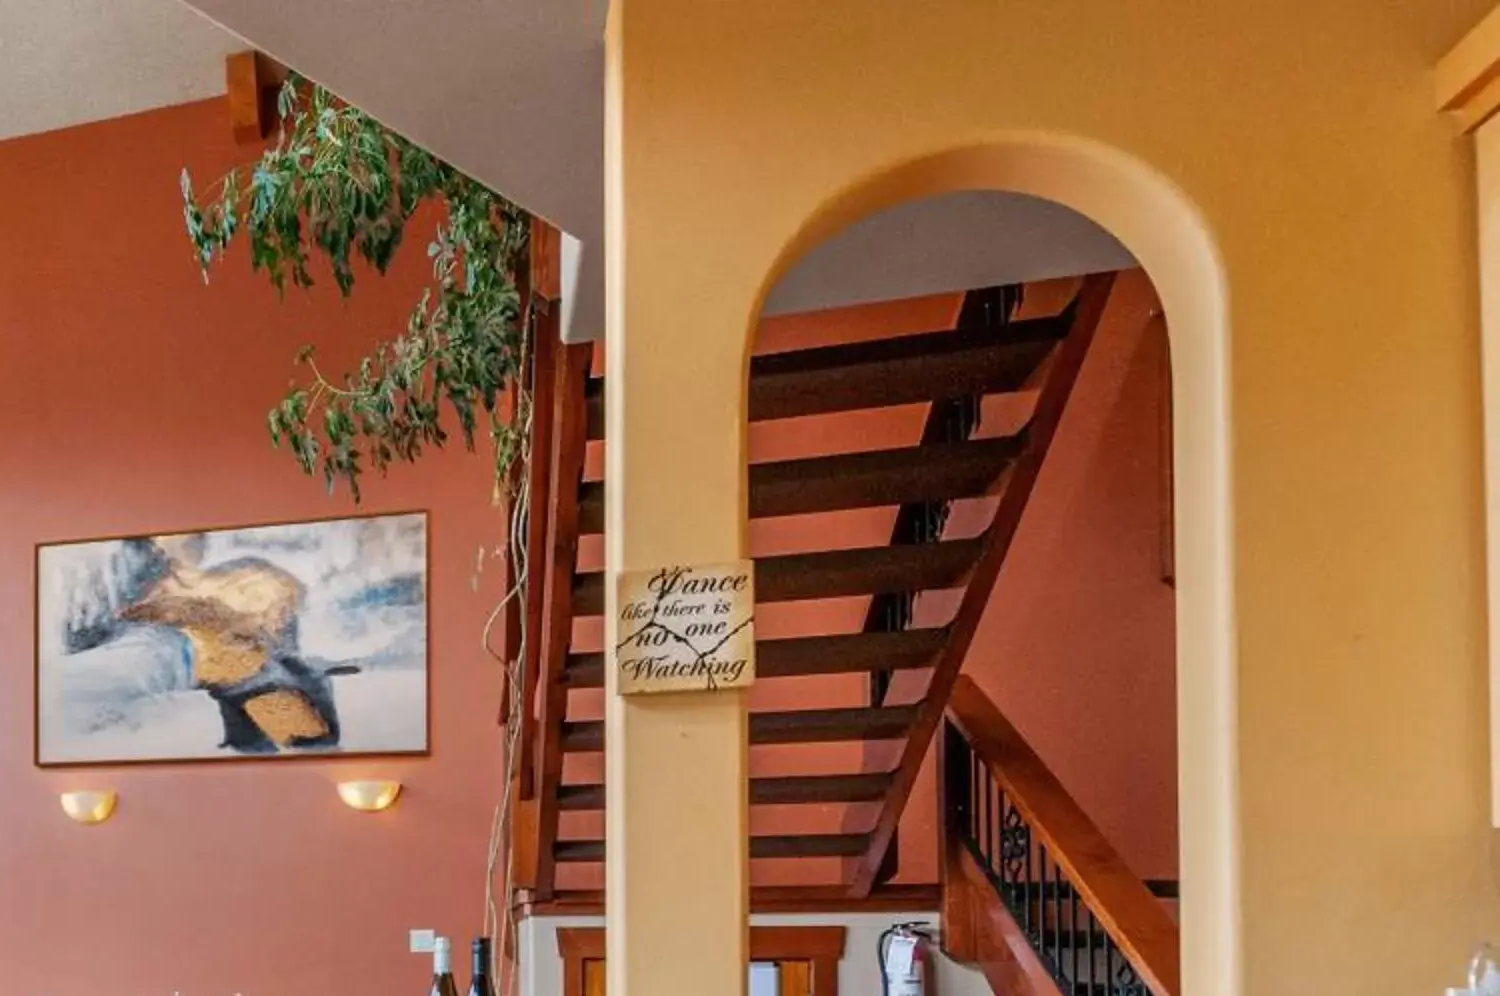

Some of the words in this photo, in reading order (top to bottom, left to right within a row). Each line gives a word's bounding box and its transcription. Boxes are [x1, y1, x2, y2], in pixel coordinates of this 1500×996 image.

[648, 566, 748, 596] Dance
[620, 601, 651, 621] like
[662, 599, 707, 617] there
[713, 598, 731, 614] is
[635, 631, 669, 648] no
[684, 620, 727, 637] one
[621, 656, 748, 682] Watching
